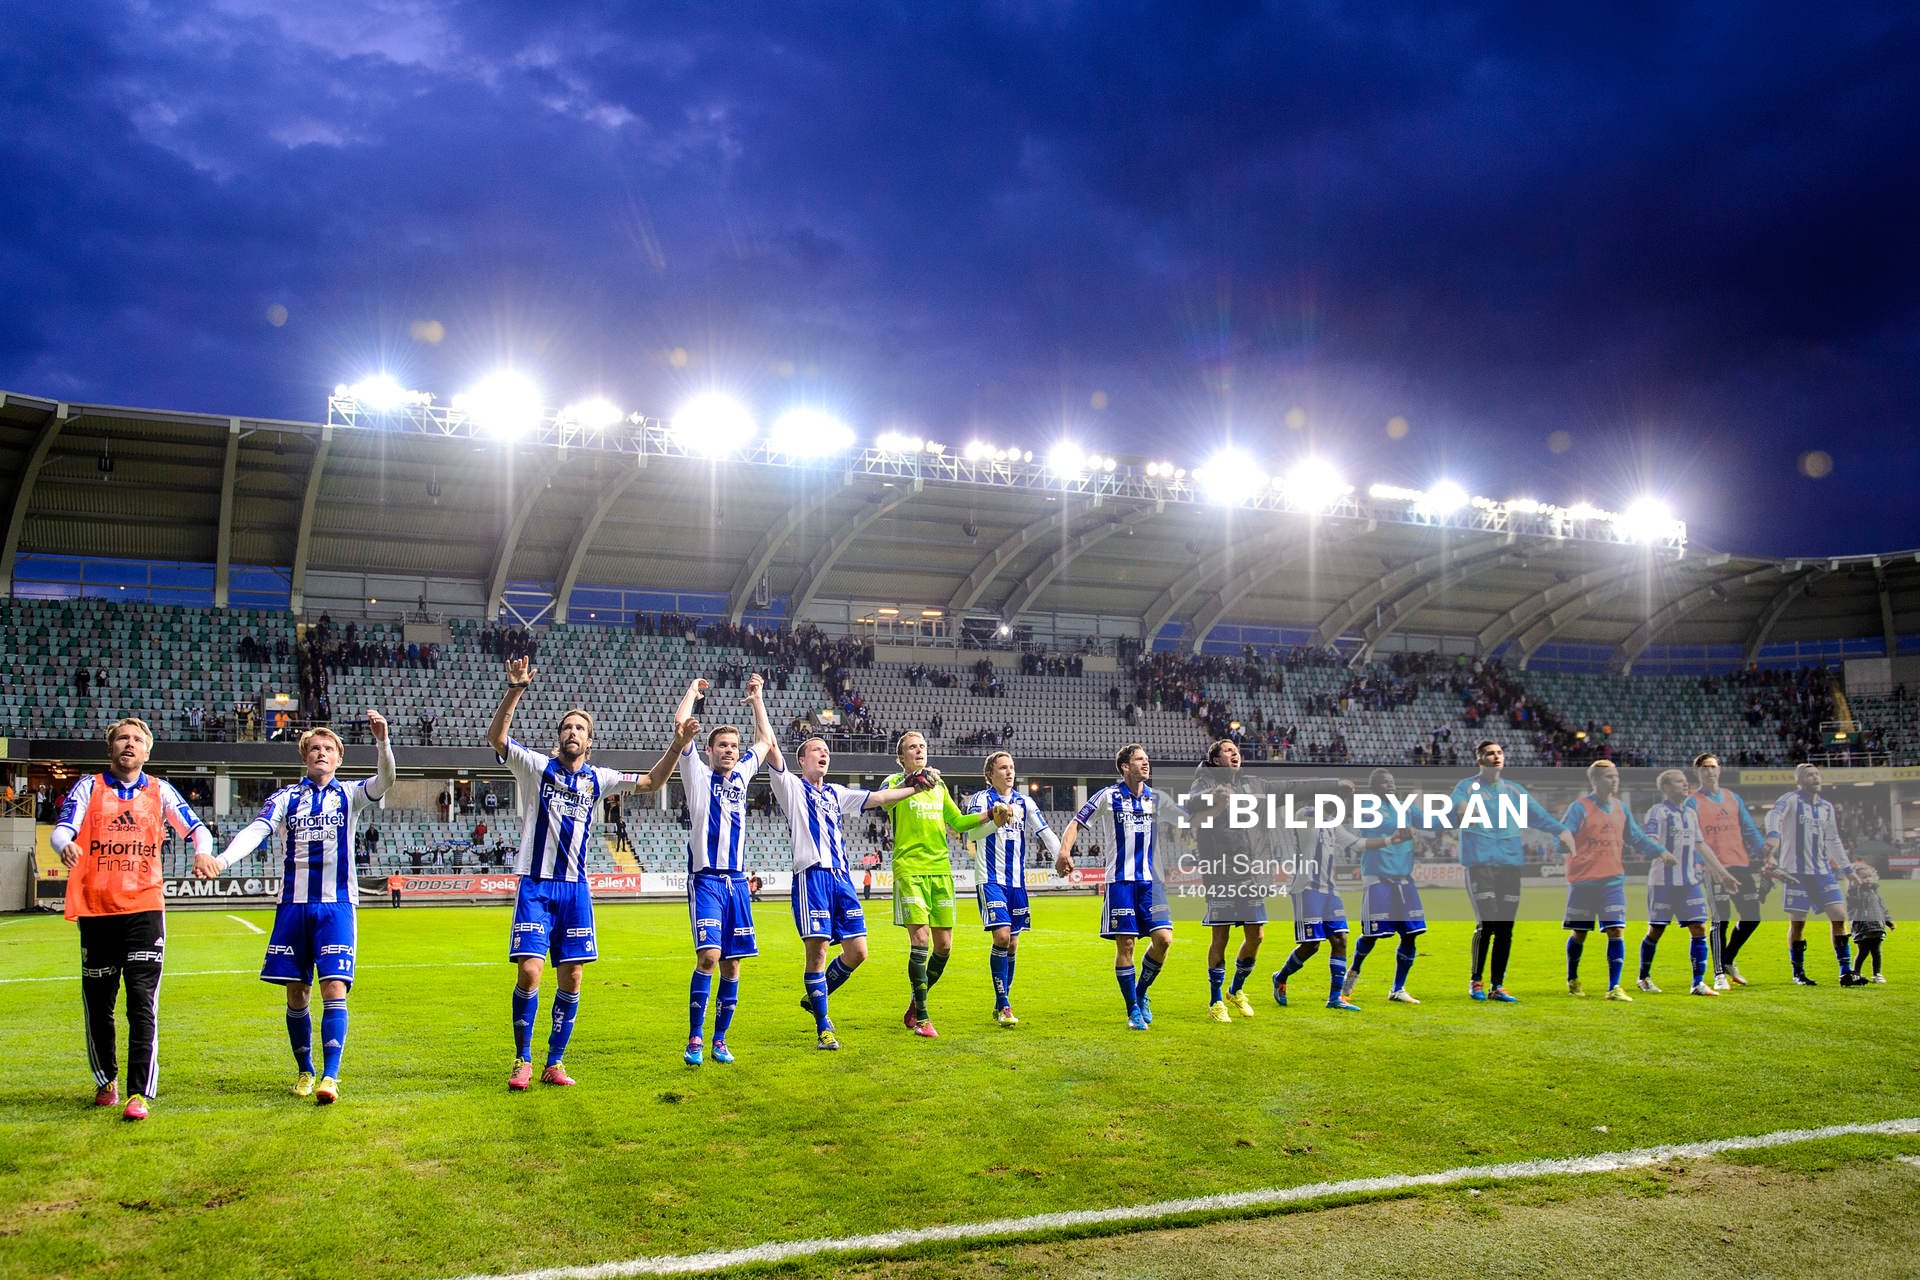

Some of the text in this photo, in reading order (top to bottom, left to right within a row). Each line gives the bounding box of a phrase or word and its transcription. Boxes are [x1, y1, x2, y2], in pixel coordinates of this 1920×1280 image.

[288, 813, 345, 830] Prioritet
[295, 829, 336, 842] Finans
[90, 840, 157, 858] Prioritet
[97, 855, 149, 873] Finans
[163, 879, 283, 897] GAMLA U
[404, 878, 516, 893] ODDSET Spela
[597, 877, 624, 888] eller
[514, 922, 545, 935] SEFA
[267, 945, 295, 956] EFA
[320, 944, 354, 956] SEFA
[127, 951, 163, 963] SEFA
